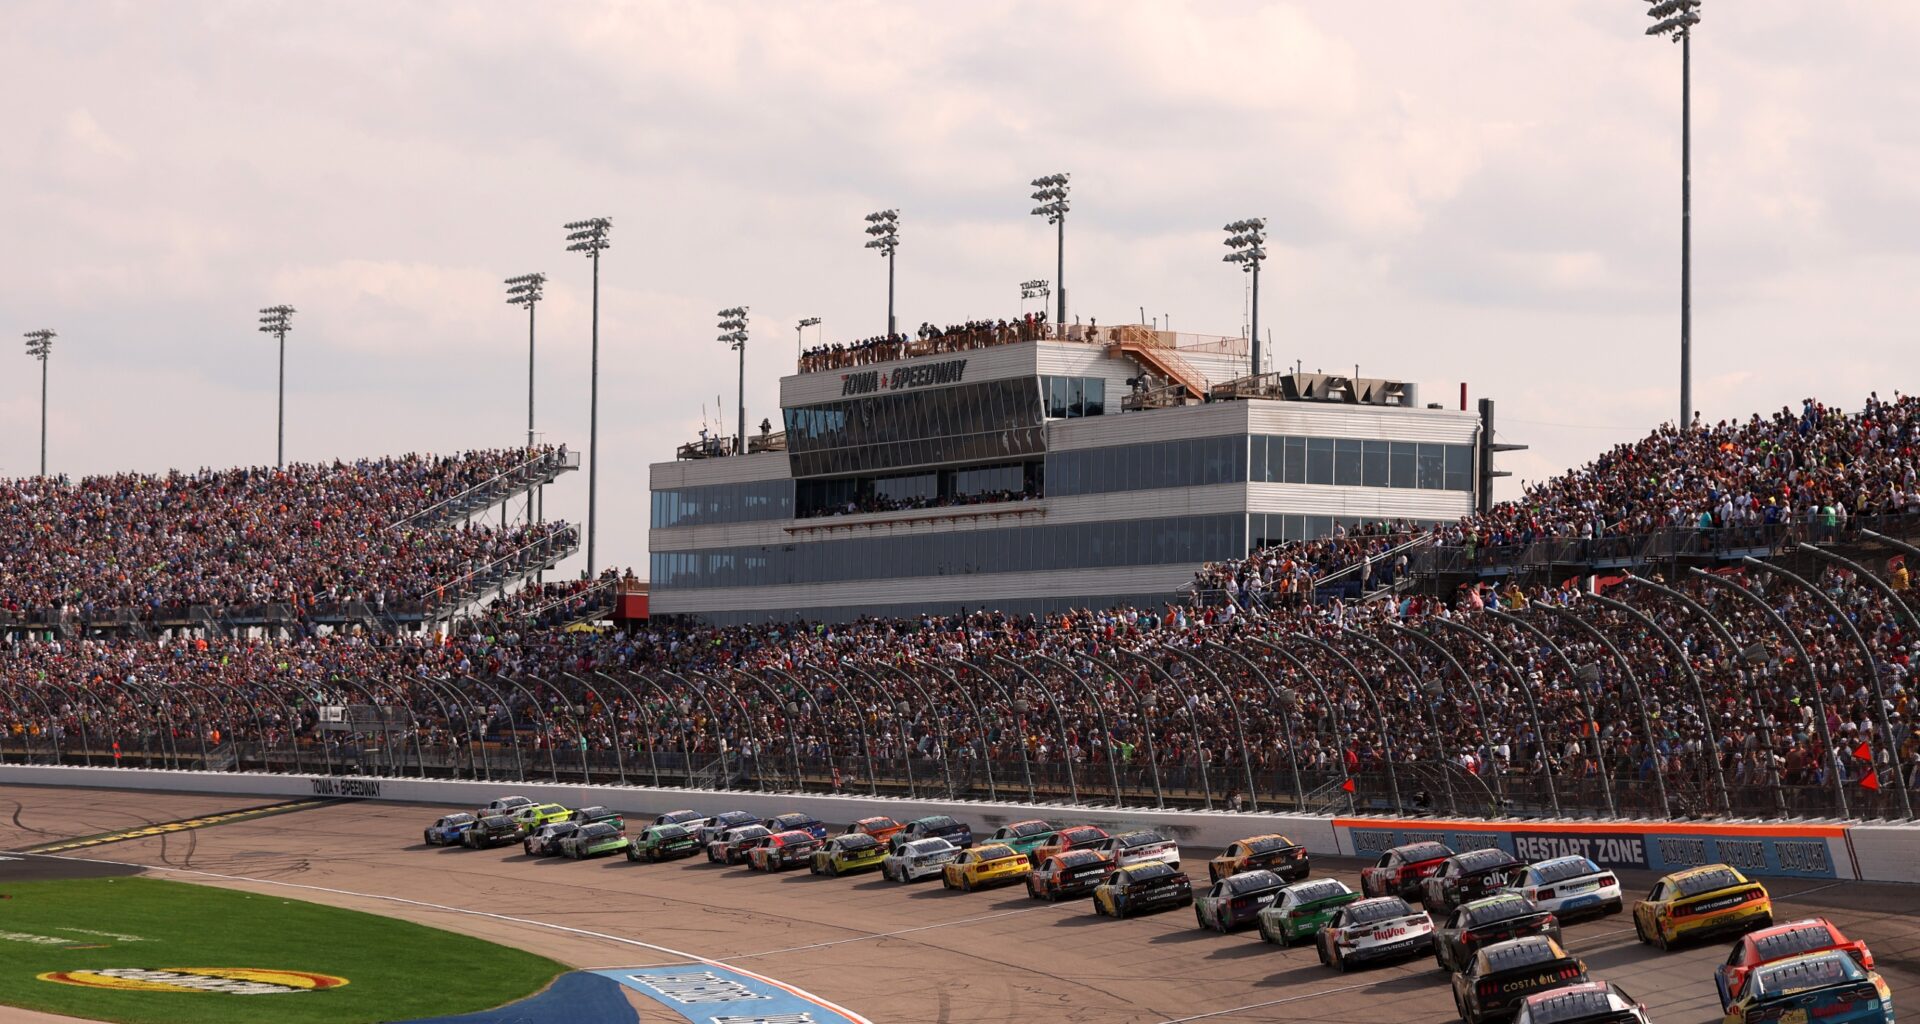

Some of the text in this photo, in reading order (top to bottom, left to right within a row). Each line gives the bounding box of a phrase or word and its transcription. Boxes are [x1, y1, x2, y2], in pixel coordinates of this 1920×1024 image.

[840, 359, 967, 396] IOWA SPEEDWAY
[311, 778, 381, 797] IOWA SPEEDWAY
[1515, 836, 1644, 864] RESTART ZONE
[1273, 863, 1293, 872] TOYOTA
[1483, 871, 1509, 886] ally
[1375, 939, 1416, 953] CHEVROLET
[1503, 980, 1537, 993] COSTA
